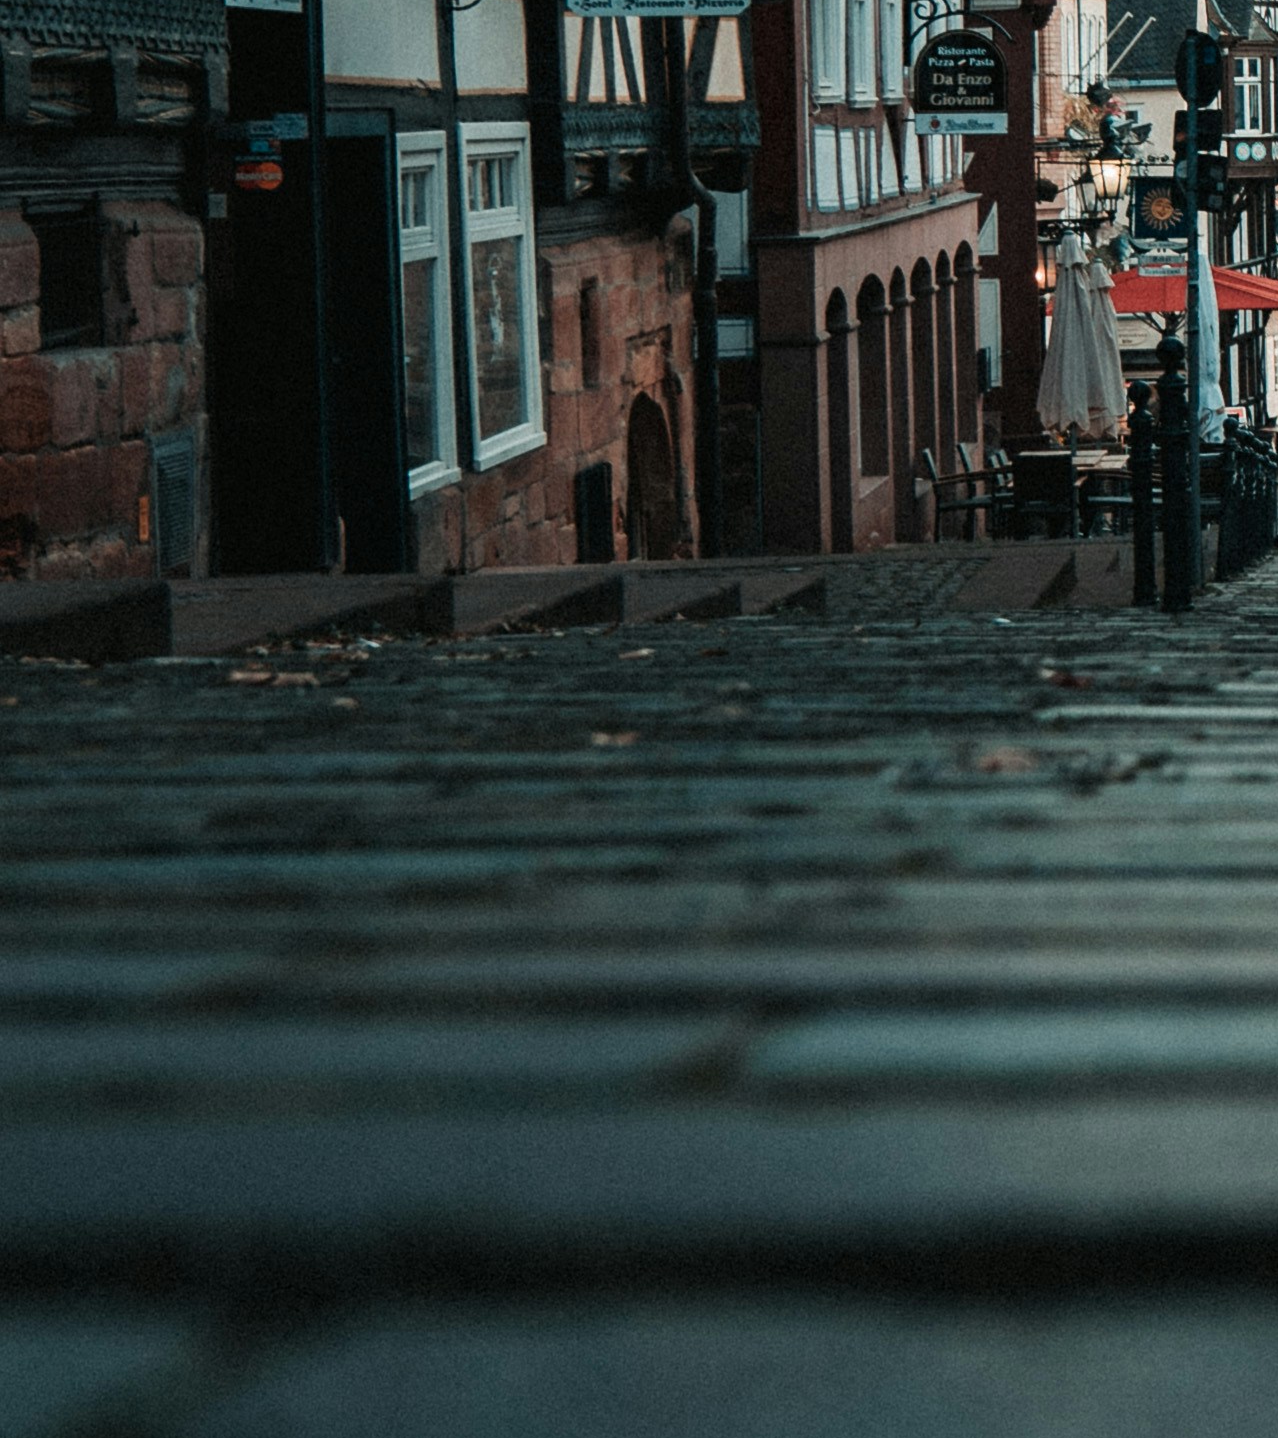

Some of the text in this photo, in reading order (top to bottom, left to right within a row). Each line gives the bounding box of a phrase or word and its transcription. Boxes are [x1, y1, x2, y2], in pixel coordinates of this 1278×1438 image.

[937, 46, 987, 55] Ristorante
[928, 58, 995, 66] Pizza Pasta
[932, 73, 992, 85] Da Enzo
[957, 87, 967, 95] &
[930, 93, 995, 106] Giovanni
